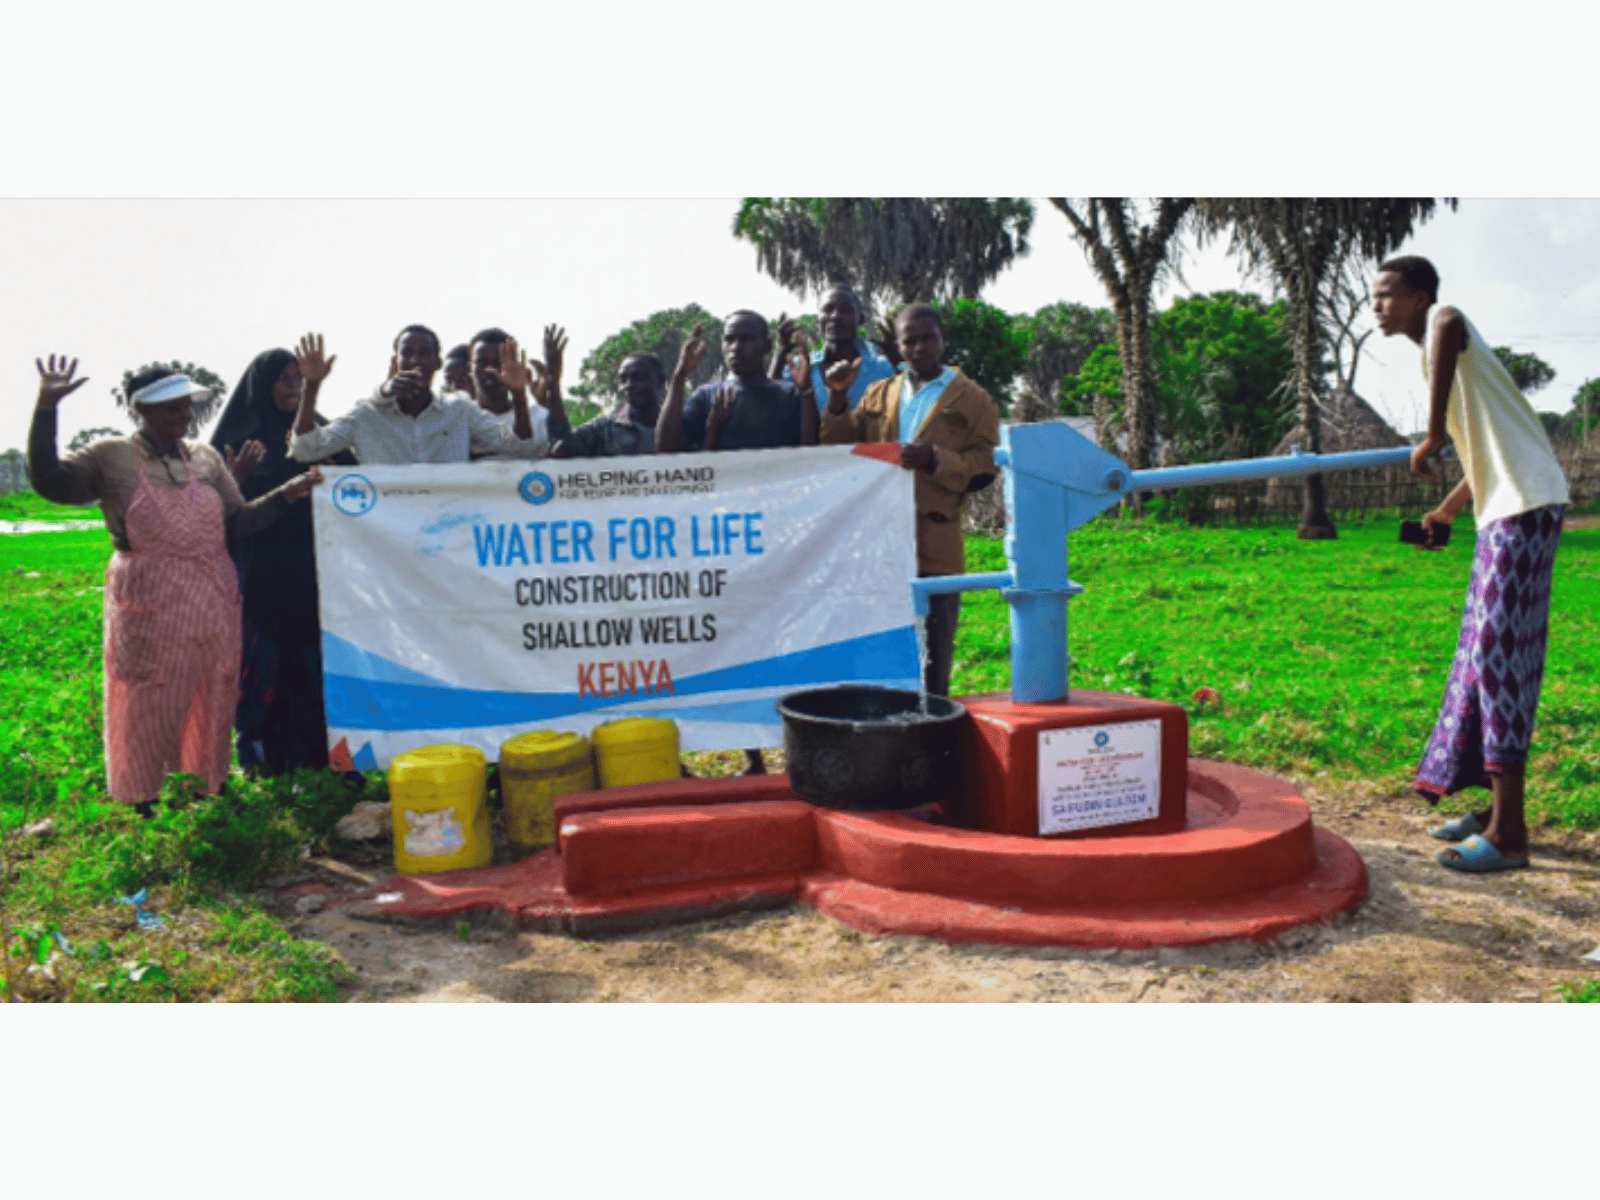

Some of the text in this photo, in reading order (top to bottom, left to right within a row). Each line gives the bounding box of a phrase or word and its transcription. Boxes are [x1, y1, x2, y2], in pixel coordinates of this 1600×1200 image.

[558, 466, 715, 488] HELPING HAND
[472, 512, 764, 567] WATER FOR LIFE
[515, 569, 728, 606] CONSTRUCTION OF
[523, 613, 717, 650] SHALLOW WELLS
[577, 658, 675, 698] KENYA
